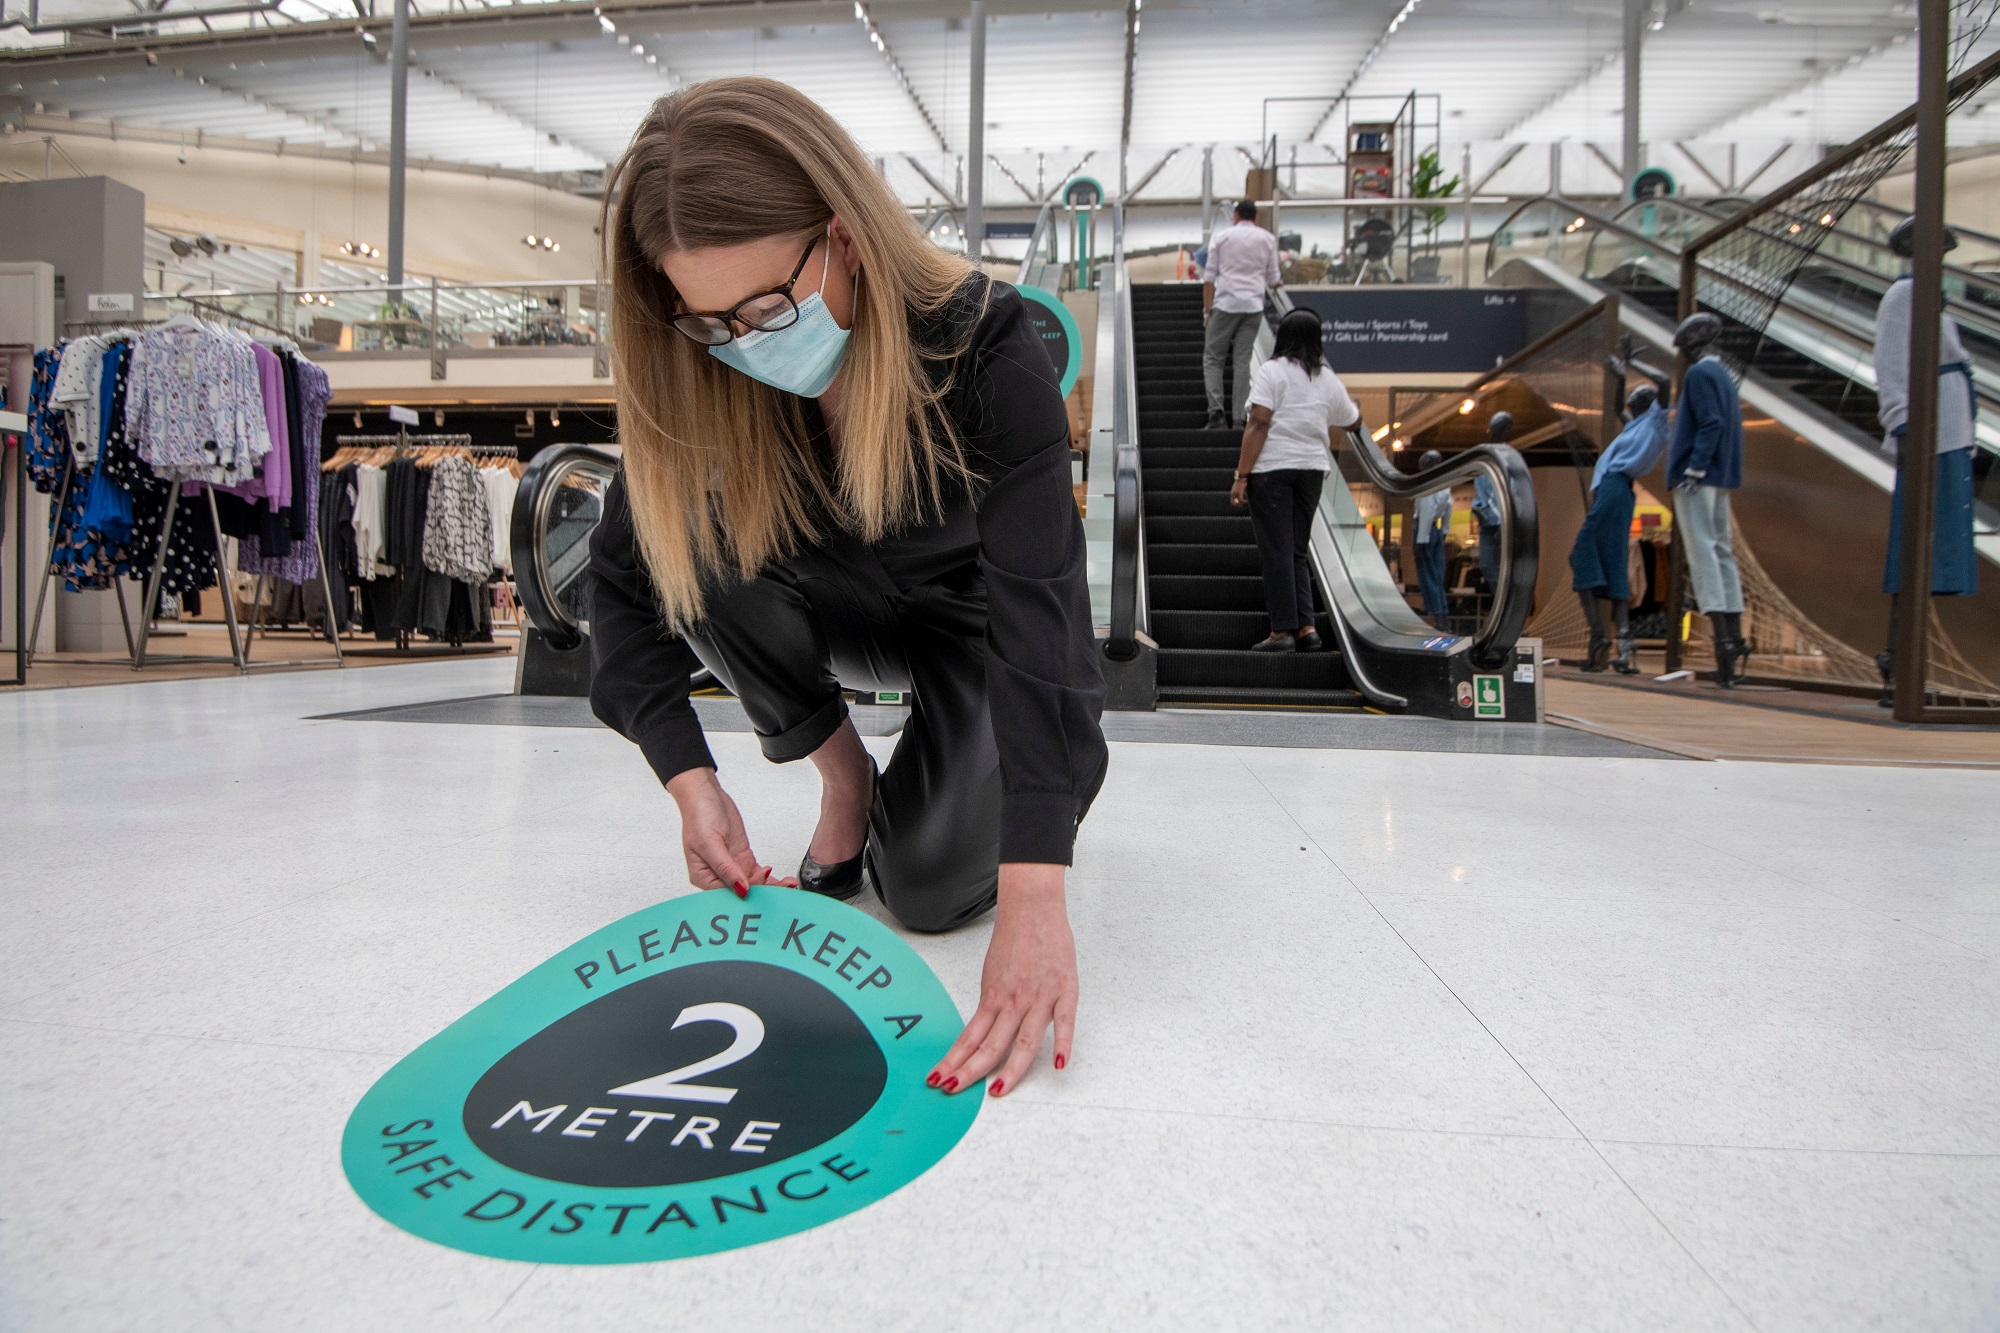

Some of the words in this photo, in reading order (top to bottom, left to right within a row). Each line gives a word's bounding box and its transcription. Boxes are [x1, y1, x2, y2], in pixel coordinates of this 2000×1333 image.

[1333, 320, 1365, 331] fashion
[1372, 319, 1402, 332] Sports
[1408, 318, 1429, 332] Toys
[1334, 332, 1352, 343] Gift
[1353, 332, 1370, 343] List
[1377, 331, 1427, 345] Partnership
[1427, 331, 1449, 343] card
[573, 913, 763, 990] PLEASE
[780, 917, 893, 991] KEEP
[883, 1013, 924, 1041] A
[606, 1001, 766, 1104] 2
[489, 1099, 782, 1155] METRE
[380, 1117, 476, 1201] SAFE
[462, 1153, 872, 1236] DISTANCE
